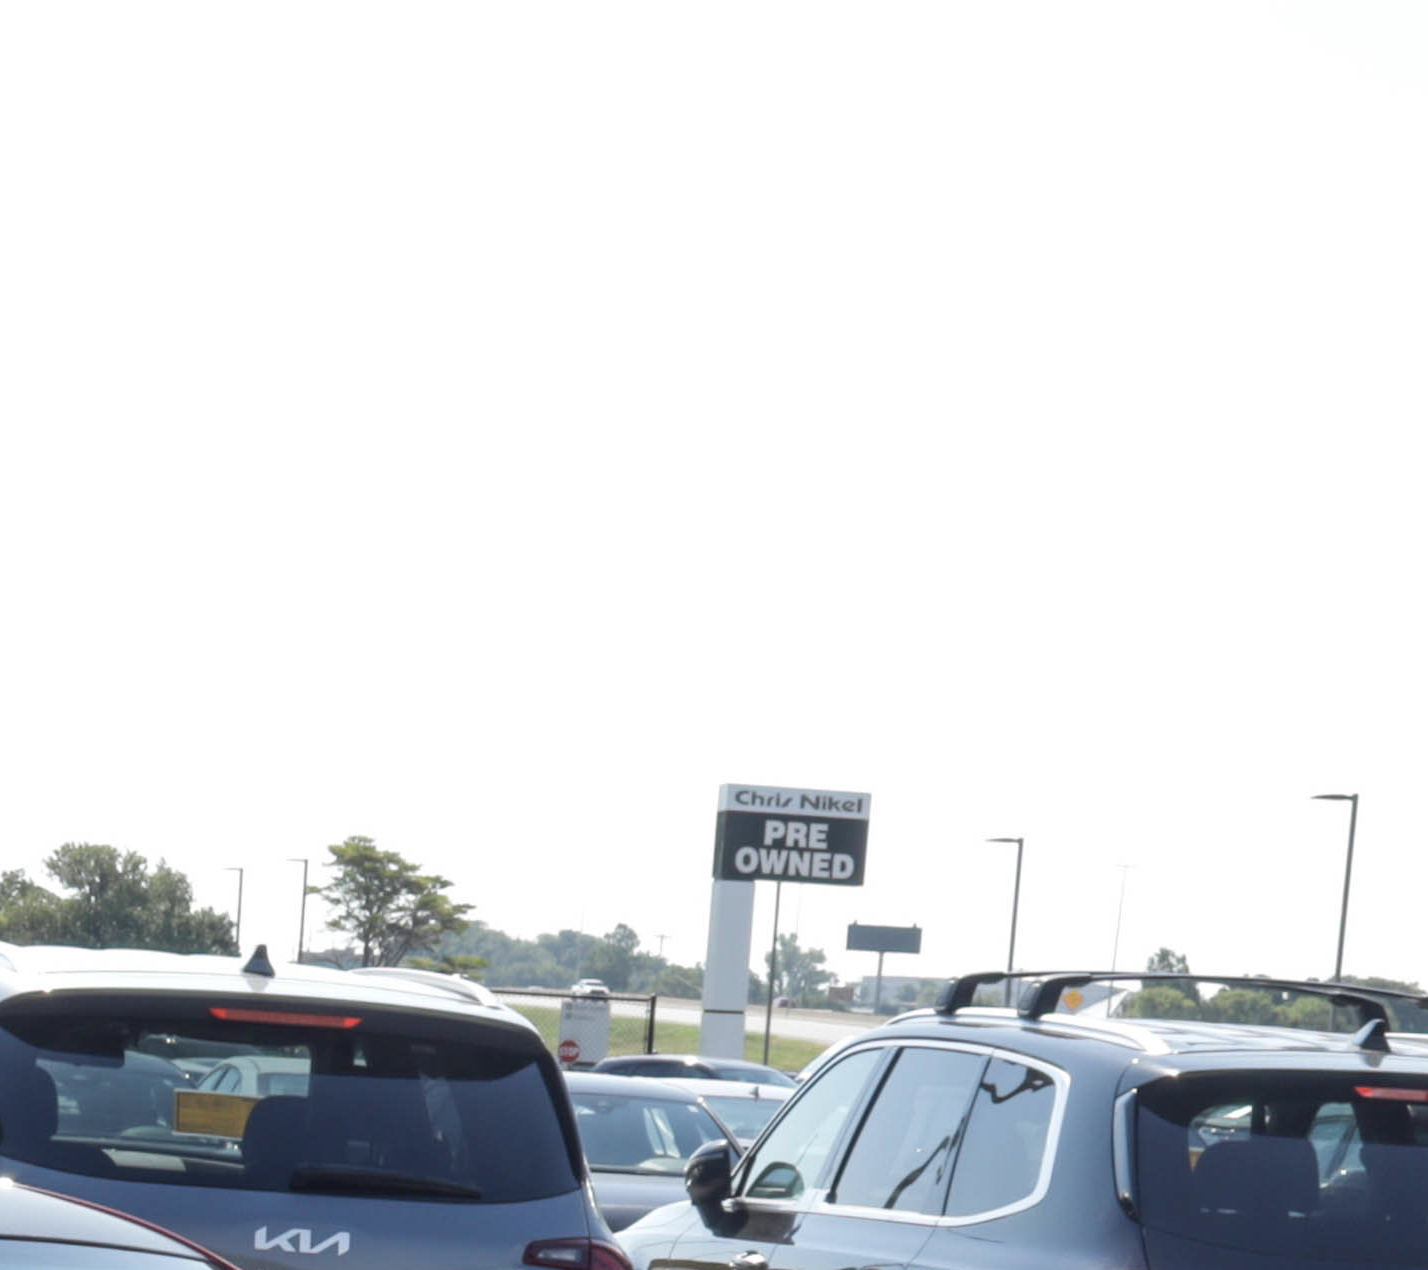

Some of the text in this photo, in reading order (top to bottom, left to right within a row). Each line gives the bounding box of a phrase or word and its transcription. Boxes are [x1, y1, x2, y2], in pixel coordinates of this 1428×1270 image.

[734, 789, 863, 813] Chris Nikel
[763, 819, 829, 849] PRE
[734, 846, 855, 880] OWNED
[254, 1225, 351, 1257] KIA
